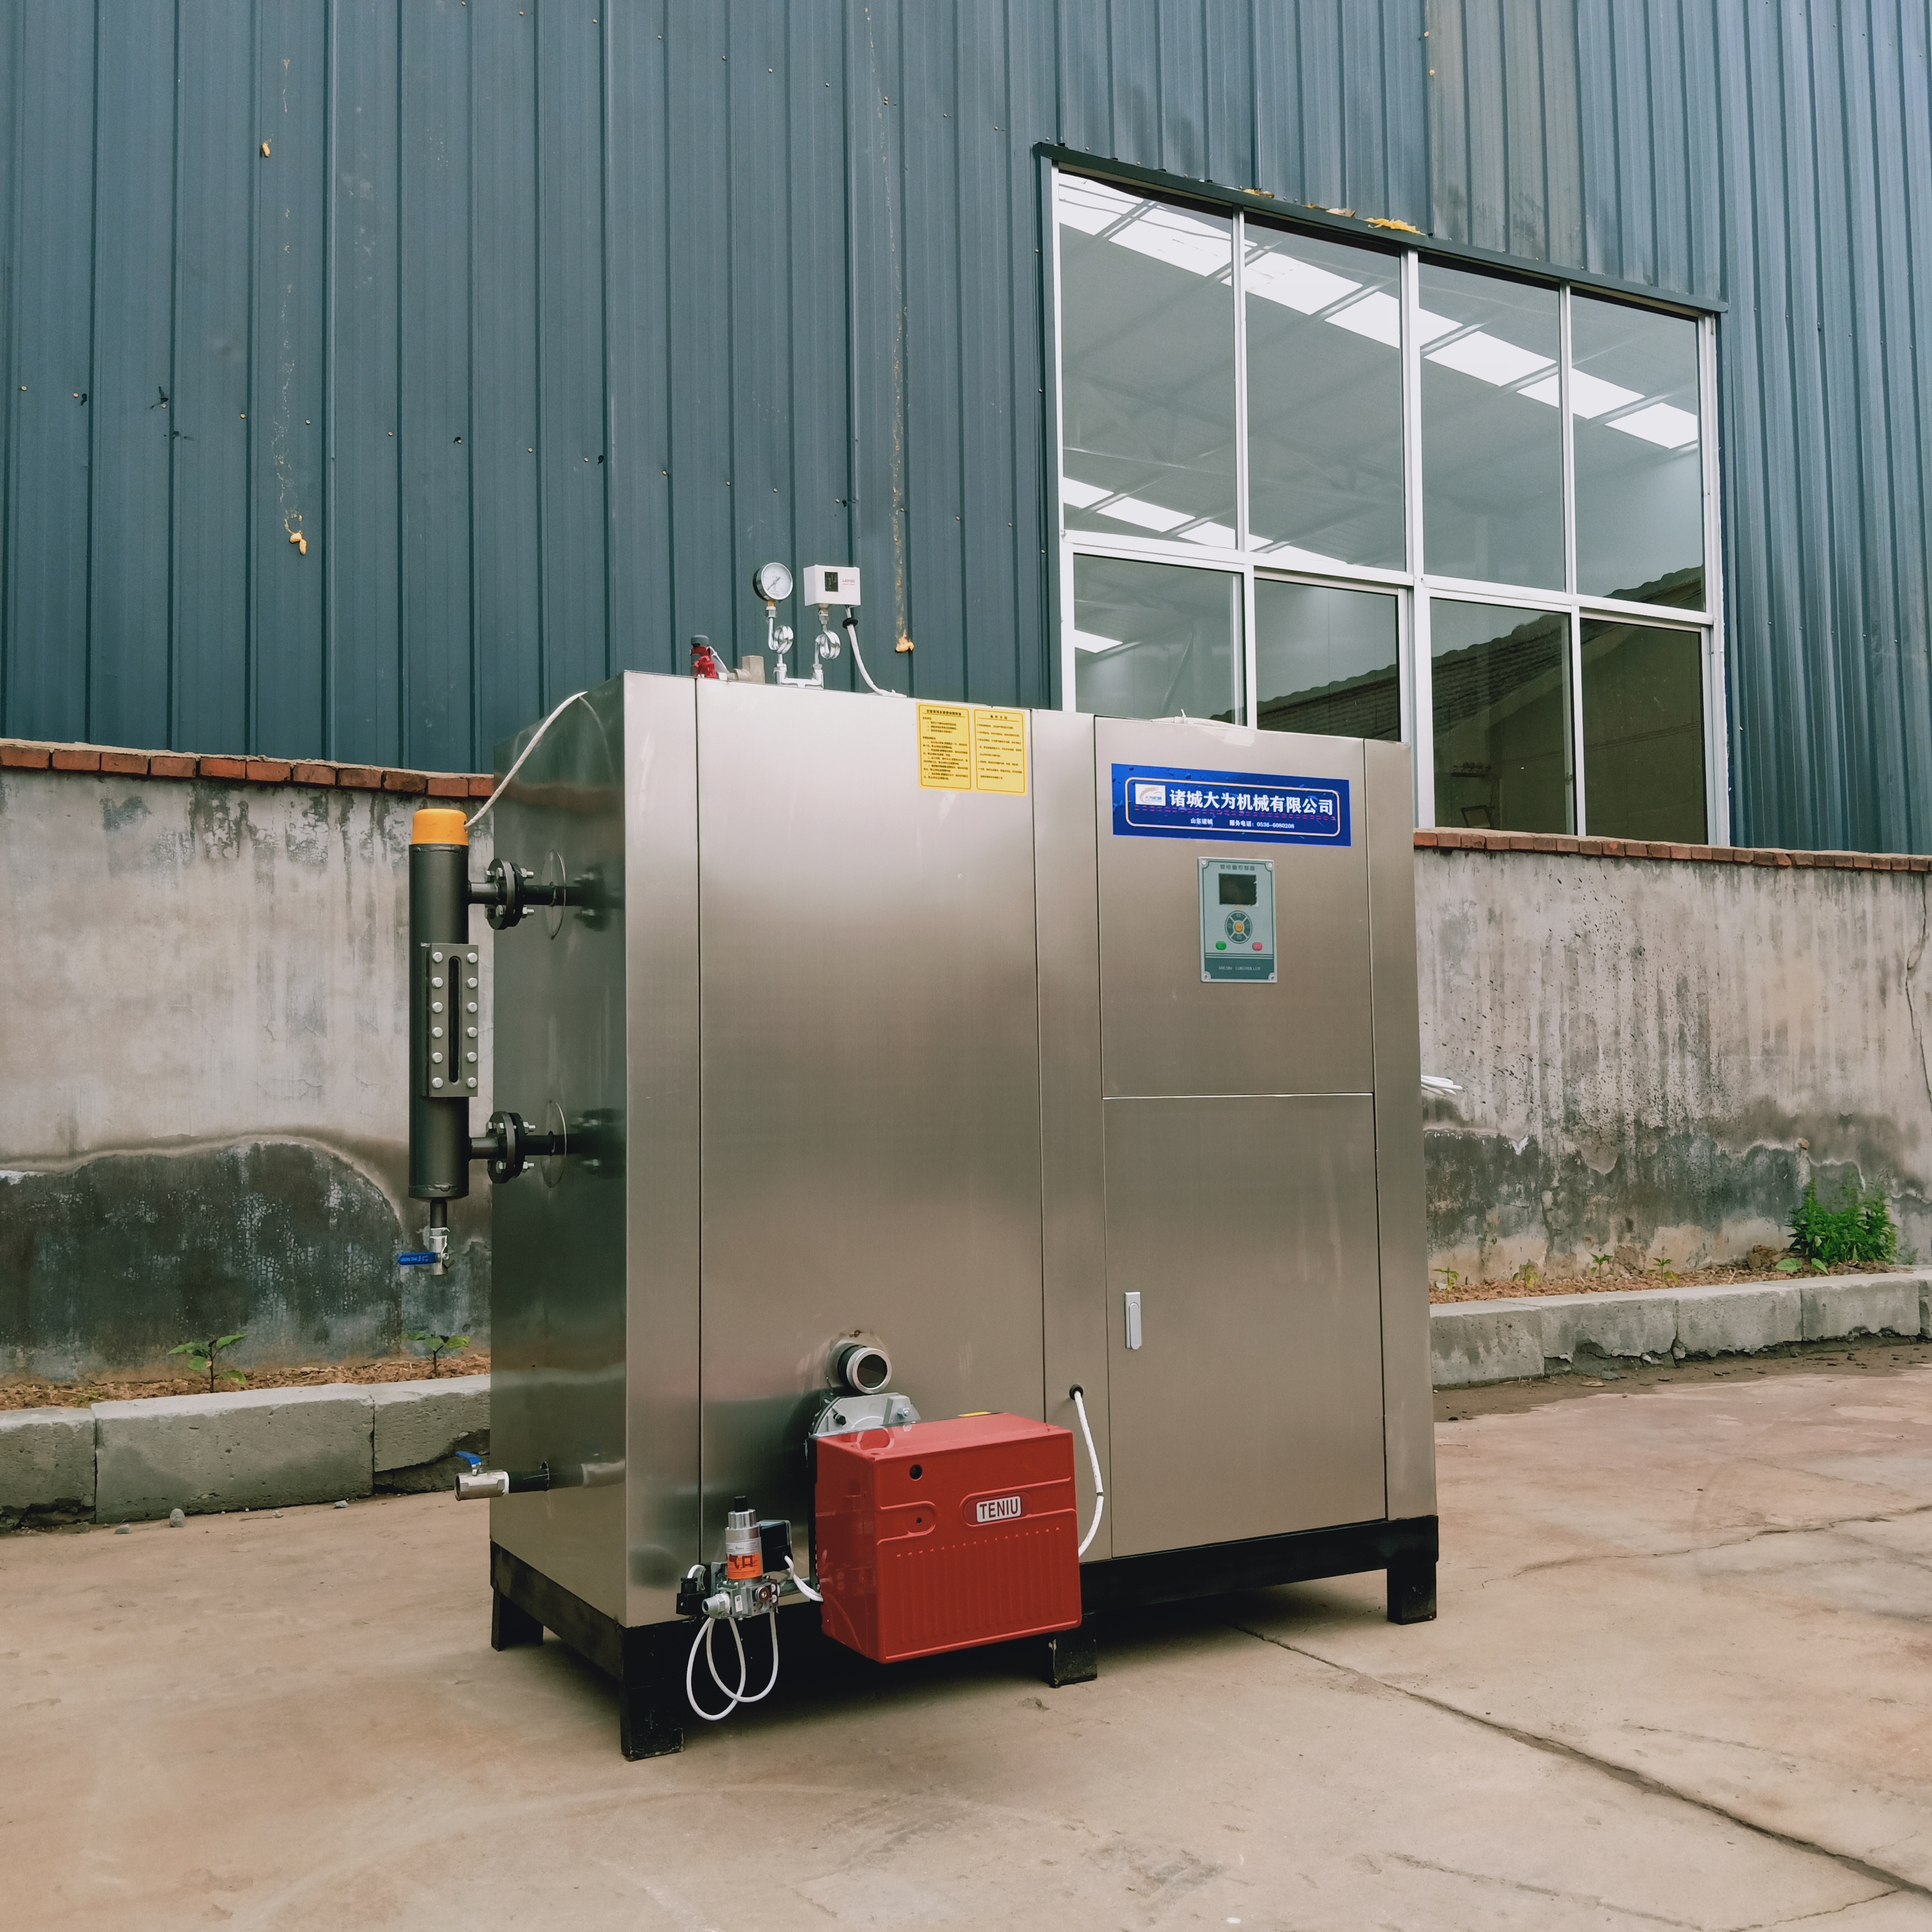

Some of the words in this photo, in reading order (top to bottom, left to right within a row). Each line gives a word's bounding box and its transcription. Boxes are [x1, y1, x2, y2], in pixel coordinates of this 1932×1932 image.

[1169, 789, 1333, 816] 诸城大为机械有限公司
[979, 1498, 1018, 1519] TENIU
